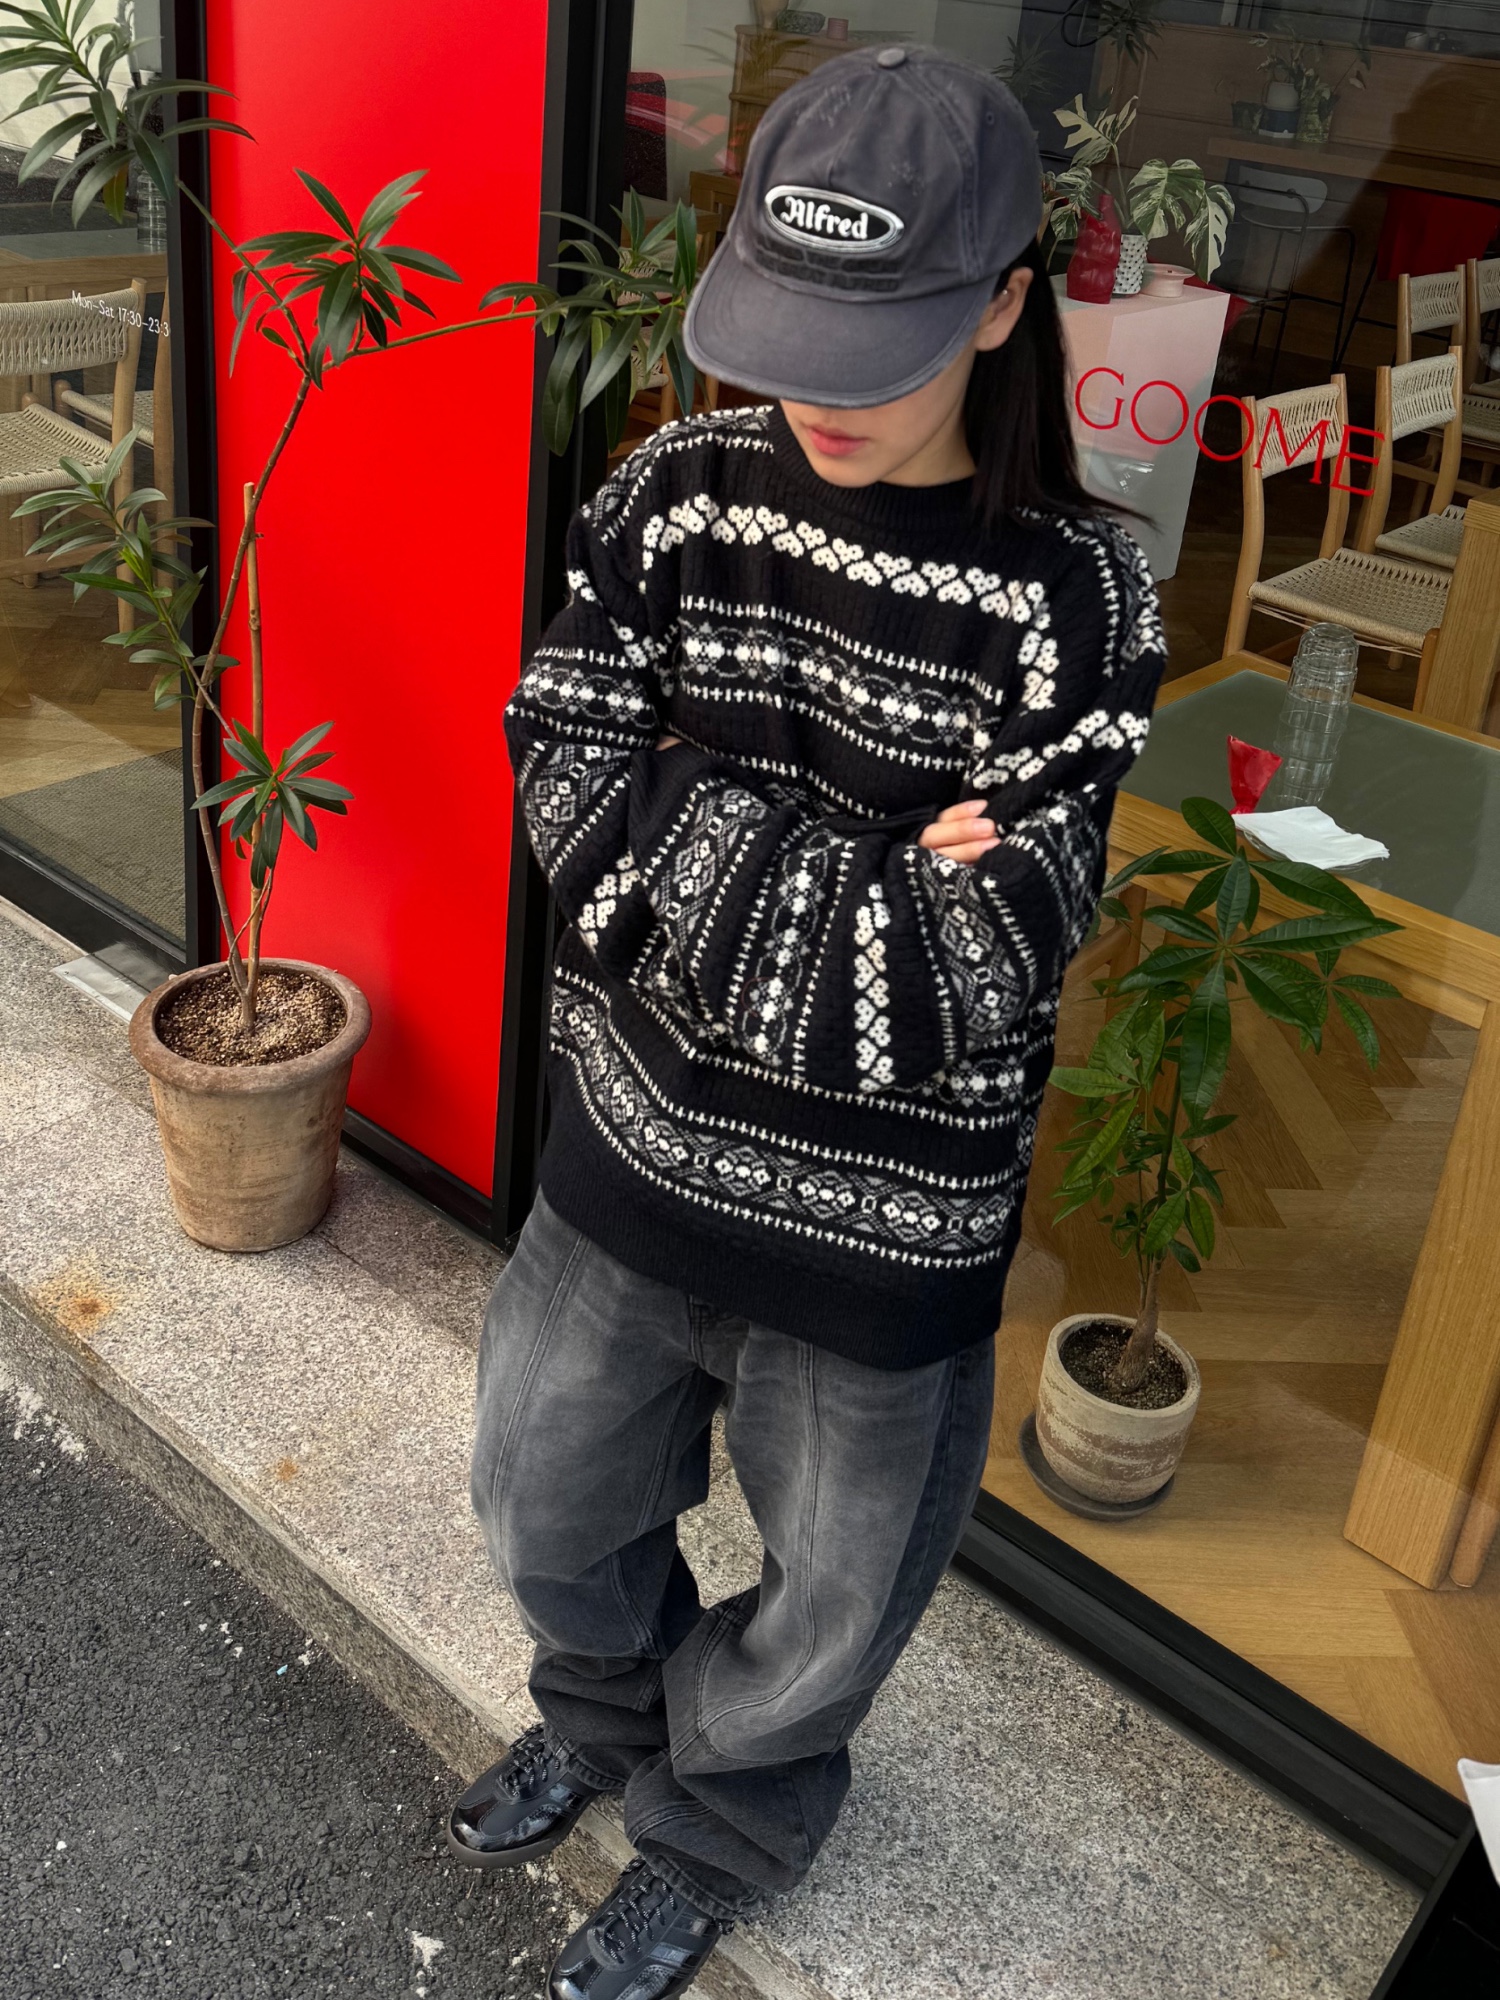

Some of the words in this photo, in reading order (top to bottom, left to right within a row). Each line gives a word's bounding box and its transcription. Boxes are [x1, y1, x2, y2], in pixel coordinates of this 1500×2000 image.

[780, 195, 869, 240] Alfred
[71, 290, 115, 318] Mon-Sat
[118, 306, 171, 337] 17:30-23:3
[1074, 366, 1386, 497] GOOME
